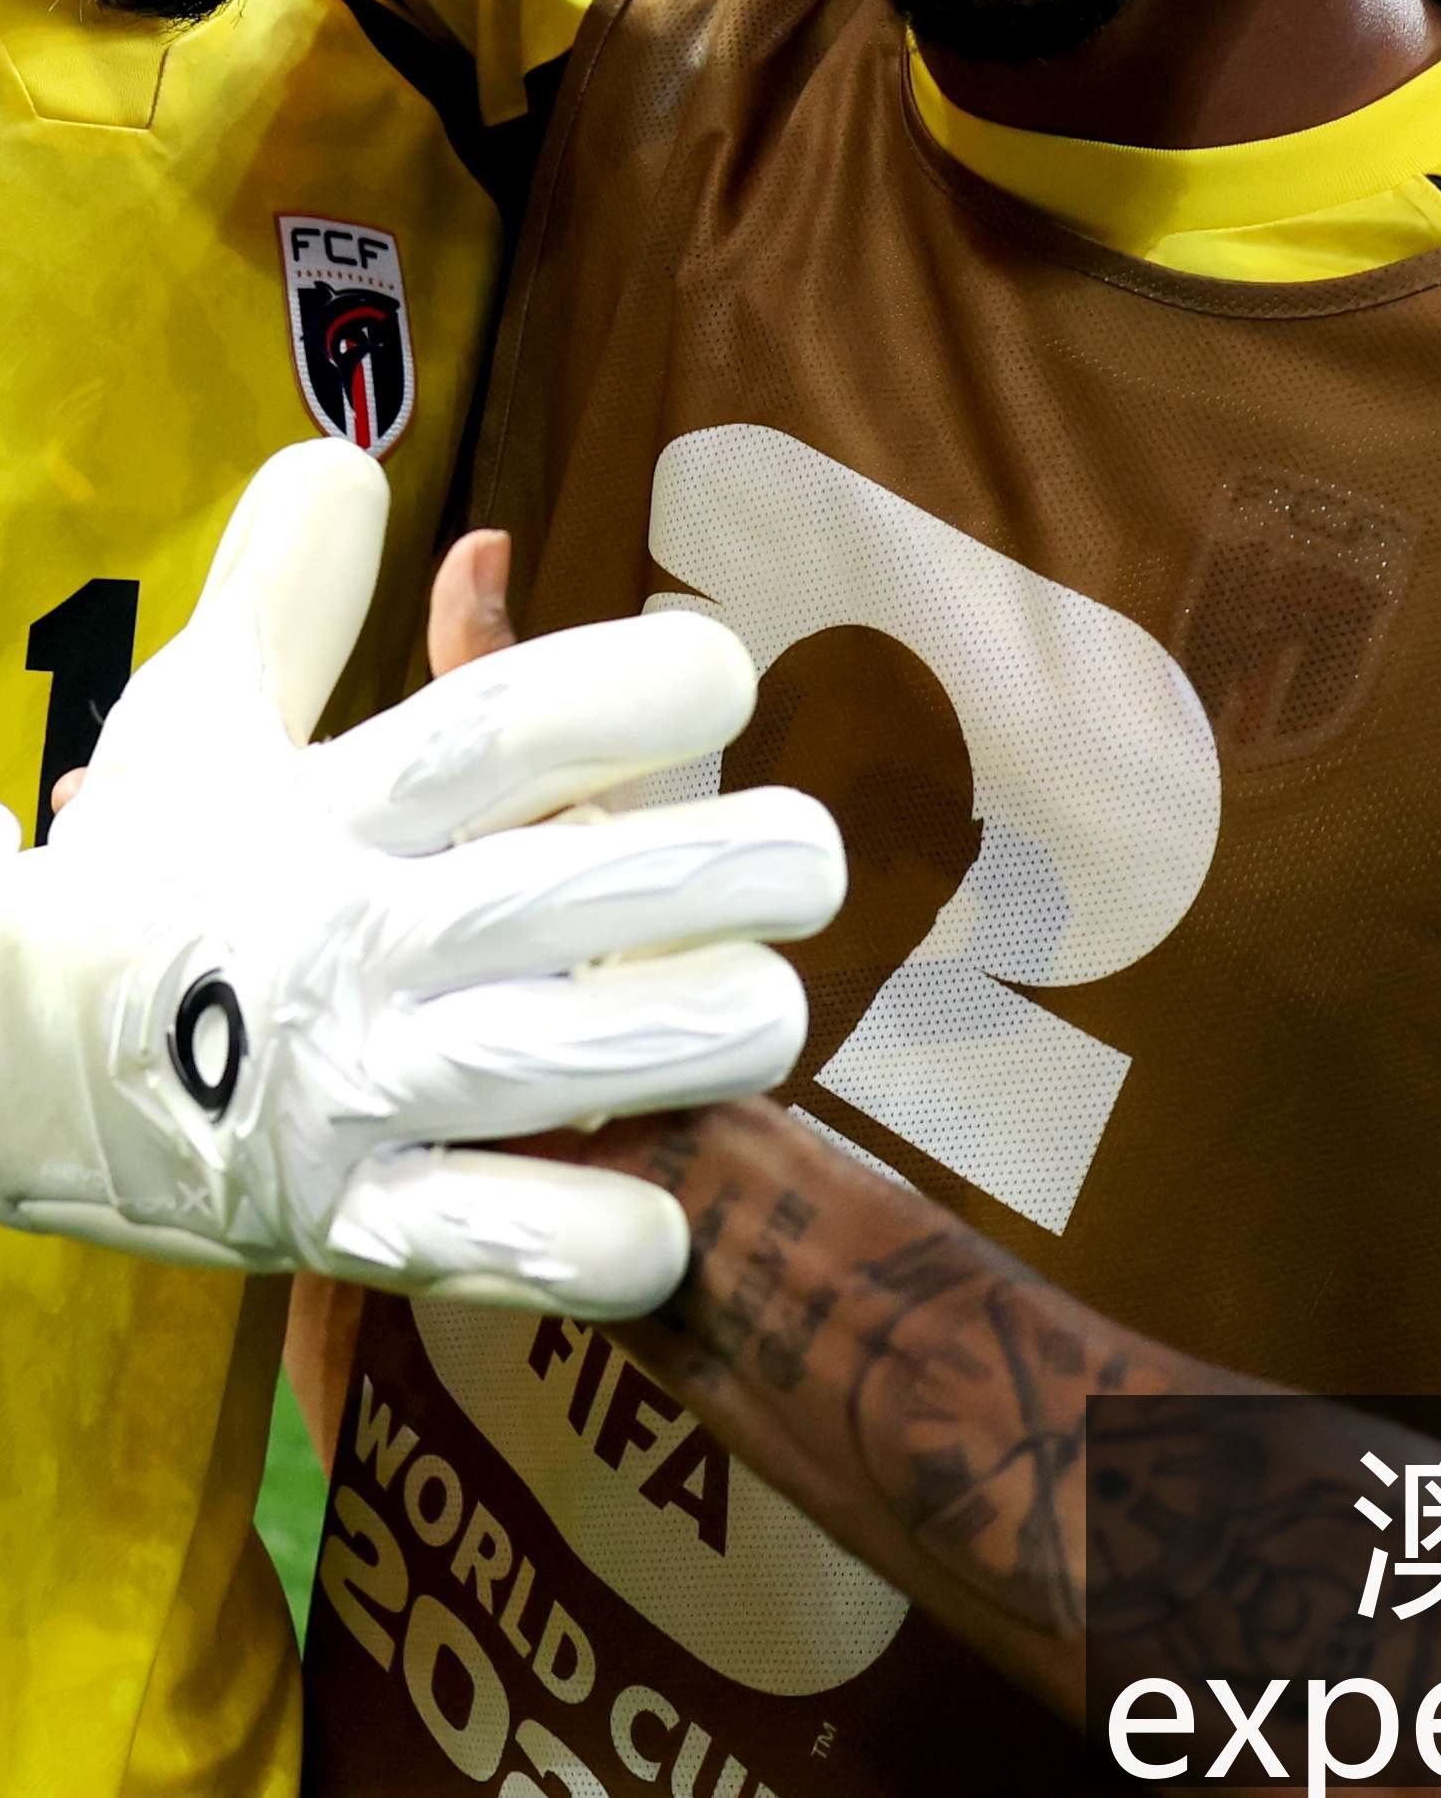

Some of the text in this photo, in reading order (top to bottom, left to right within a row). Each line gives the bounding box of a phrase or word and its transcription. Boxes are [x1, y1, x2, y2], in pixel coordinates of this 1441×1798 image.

[291, 228, 389, 270] FCF
[25, 578, 140, 848] 1
[354, 1373, 781, 1798] WORLD CU
